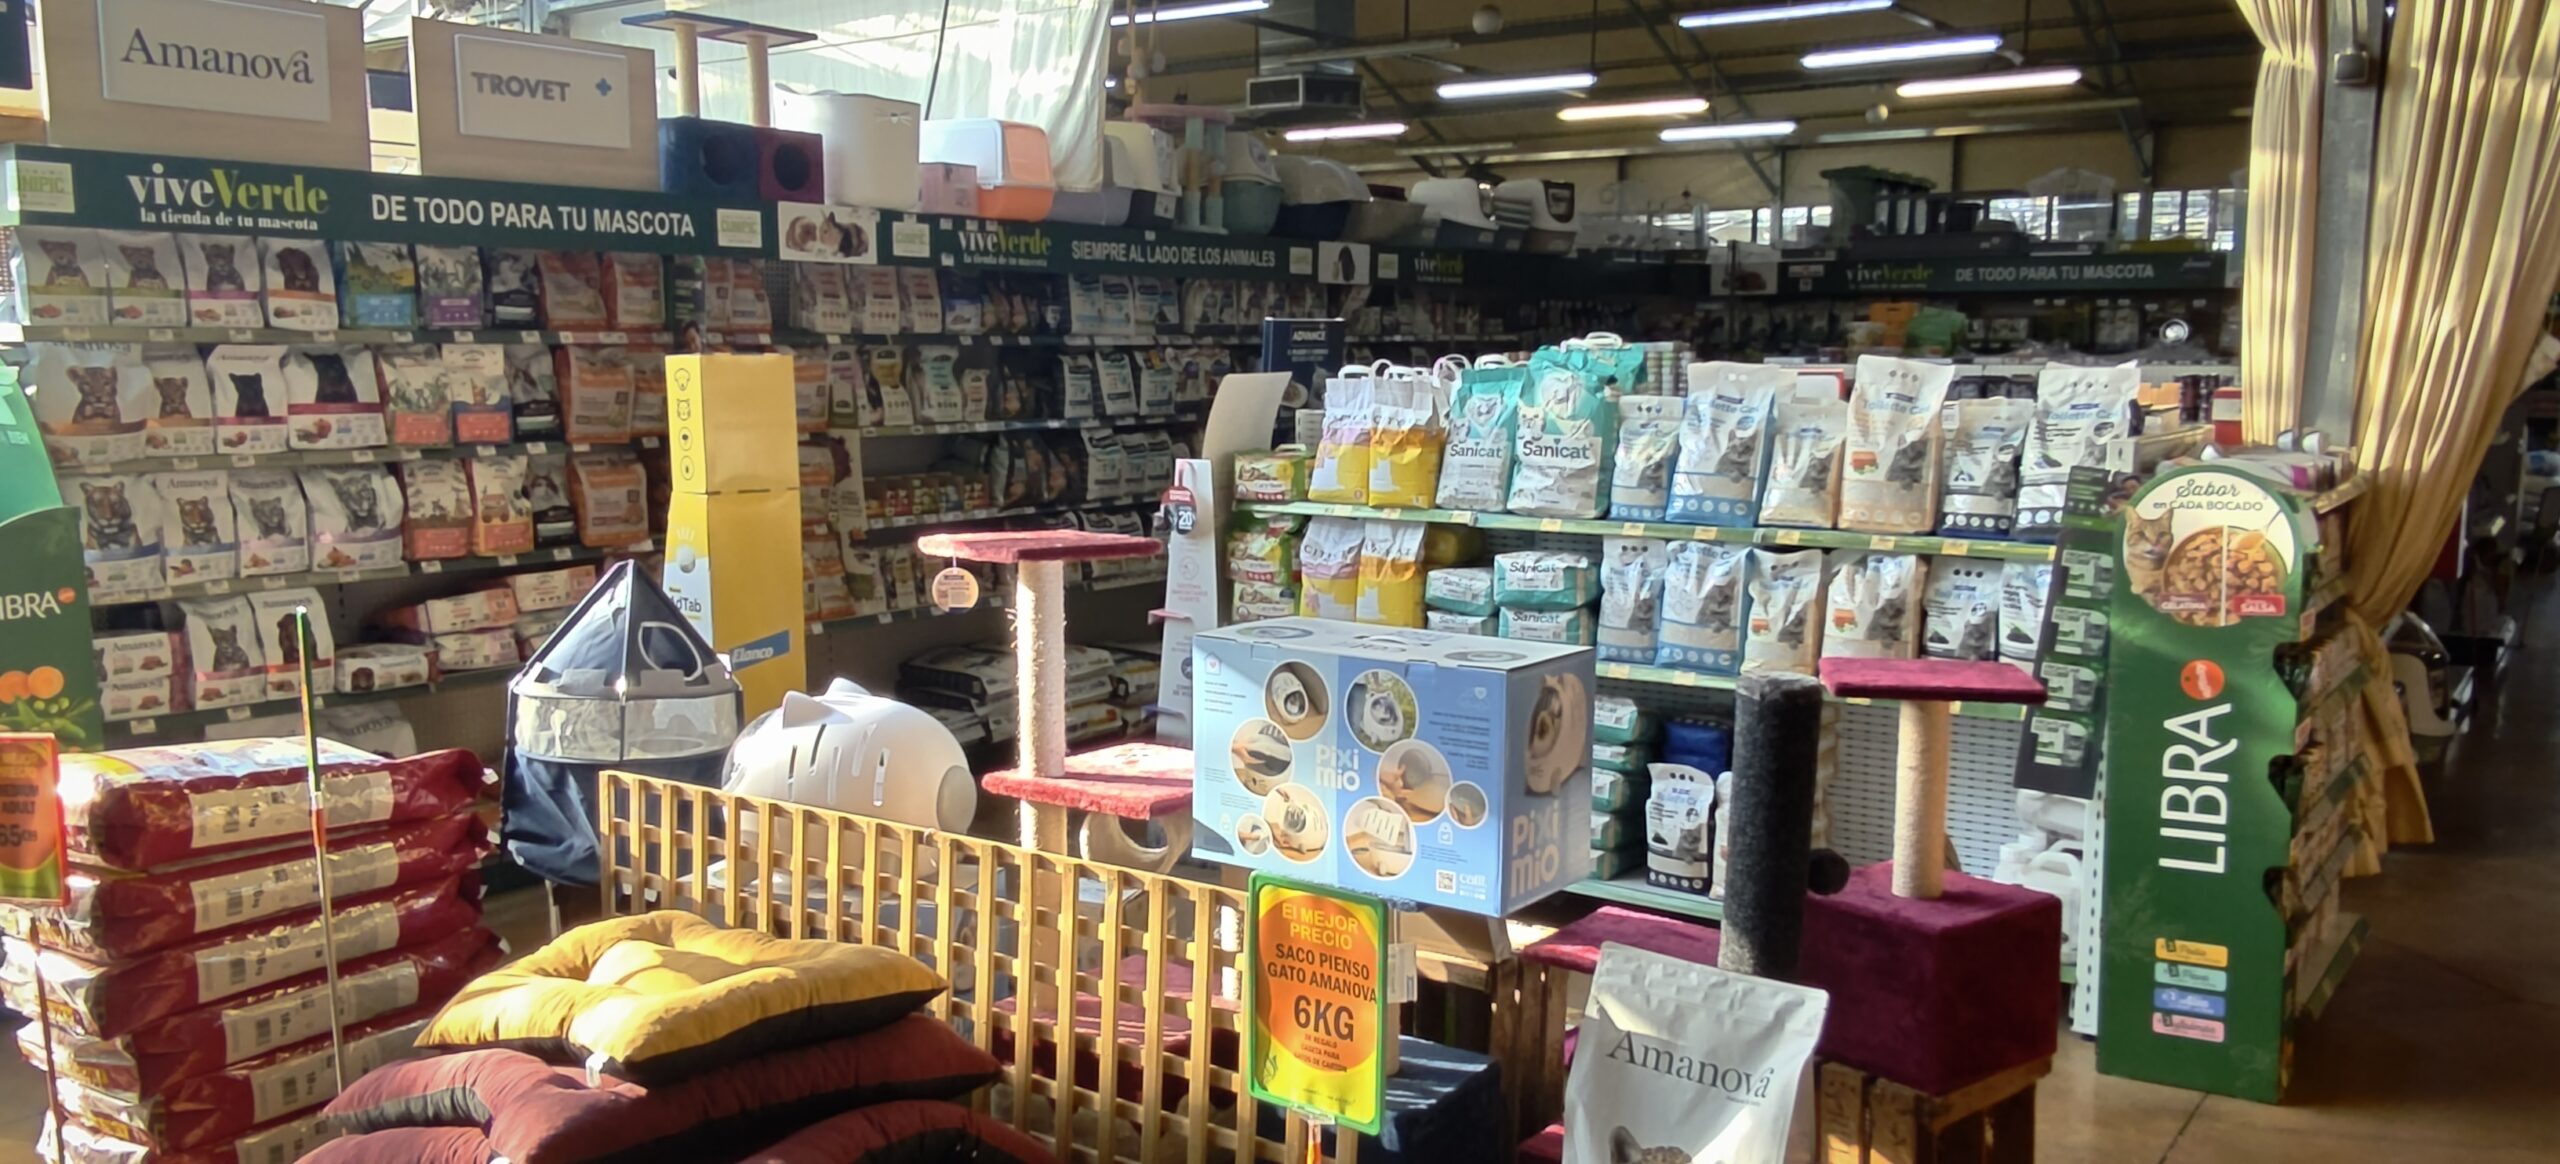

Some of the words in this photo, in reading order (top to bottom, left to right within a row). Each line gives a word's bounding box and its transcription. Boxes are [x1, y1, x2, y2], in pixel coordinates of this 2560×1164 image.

[471, 71, 570, 102] TROVET
[127, 163, 329, 214] viveVerde
[140, 208, 156, 223] la
[161, 208, 211, 226] tienda
[215, 211, 233, 227] de
[237, 213, 254, 228] tu
[257, 215, 318, 231] mascota
[371, 193, 407, 222] DE
[413, 197, 485, 227] TODO
[490, 204, 553, 231] PARA
[557, 206, 588, 232] TU
[593, 210, 696, 238] MASCOTA
[1071, 239, 1128, 262] SIEMPRE
[1129, 244, 1146, 262] AL
[1147, 245, 1180, 265] LADO
[1181, 246, 1197, 264] DE
[1199, 247, 1222, 265] LOS
[1222, 248, 1276, 268] ANIMALES
[1955, 267, 1973, 282] DE
[1977, 266, 2016, 281] TODO
[2019, 265, 2056, 281] PARA
[2061, 264, 2080, 279] TU
[2083, 264, 2155, 279] MASCOTA
[1450, 442, 1502, 459] Sanicat
[1522, 440, 1590, 460] Sanicat
[2176, 478, 2240, 500] Sabor
[2153, 501, 2168, 510] en
[2170, 501, 2204, 511] CADA
[2206, 501, 2263, 512] BOCADO
[671, 596, 702, 613] dTab
[1512, 609, 1561, 624] Sanicat
[2240, 602, 2277, 613] SALSA
[732, 647, 773, 664] Elanco
[1316, 745, 1359, 771] Pixi
[2159, 702, 2238, 874] LIBRA
[1512, 799, 1559, 857] Pixi
[1301, 906, 1359, 934] MEJOR
[1290, 921, 1353, 951] PRECIO
[1275, 943, 1315, 966] SACO
[1319, 952, 1370, 981] PIENSO
[1267, 962, 1307, 983] GATO
[1309, 970, 1379, 1005] AMANOVA
[1294, 994, 1355, 1042] 6KG
